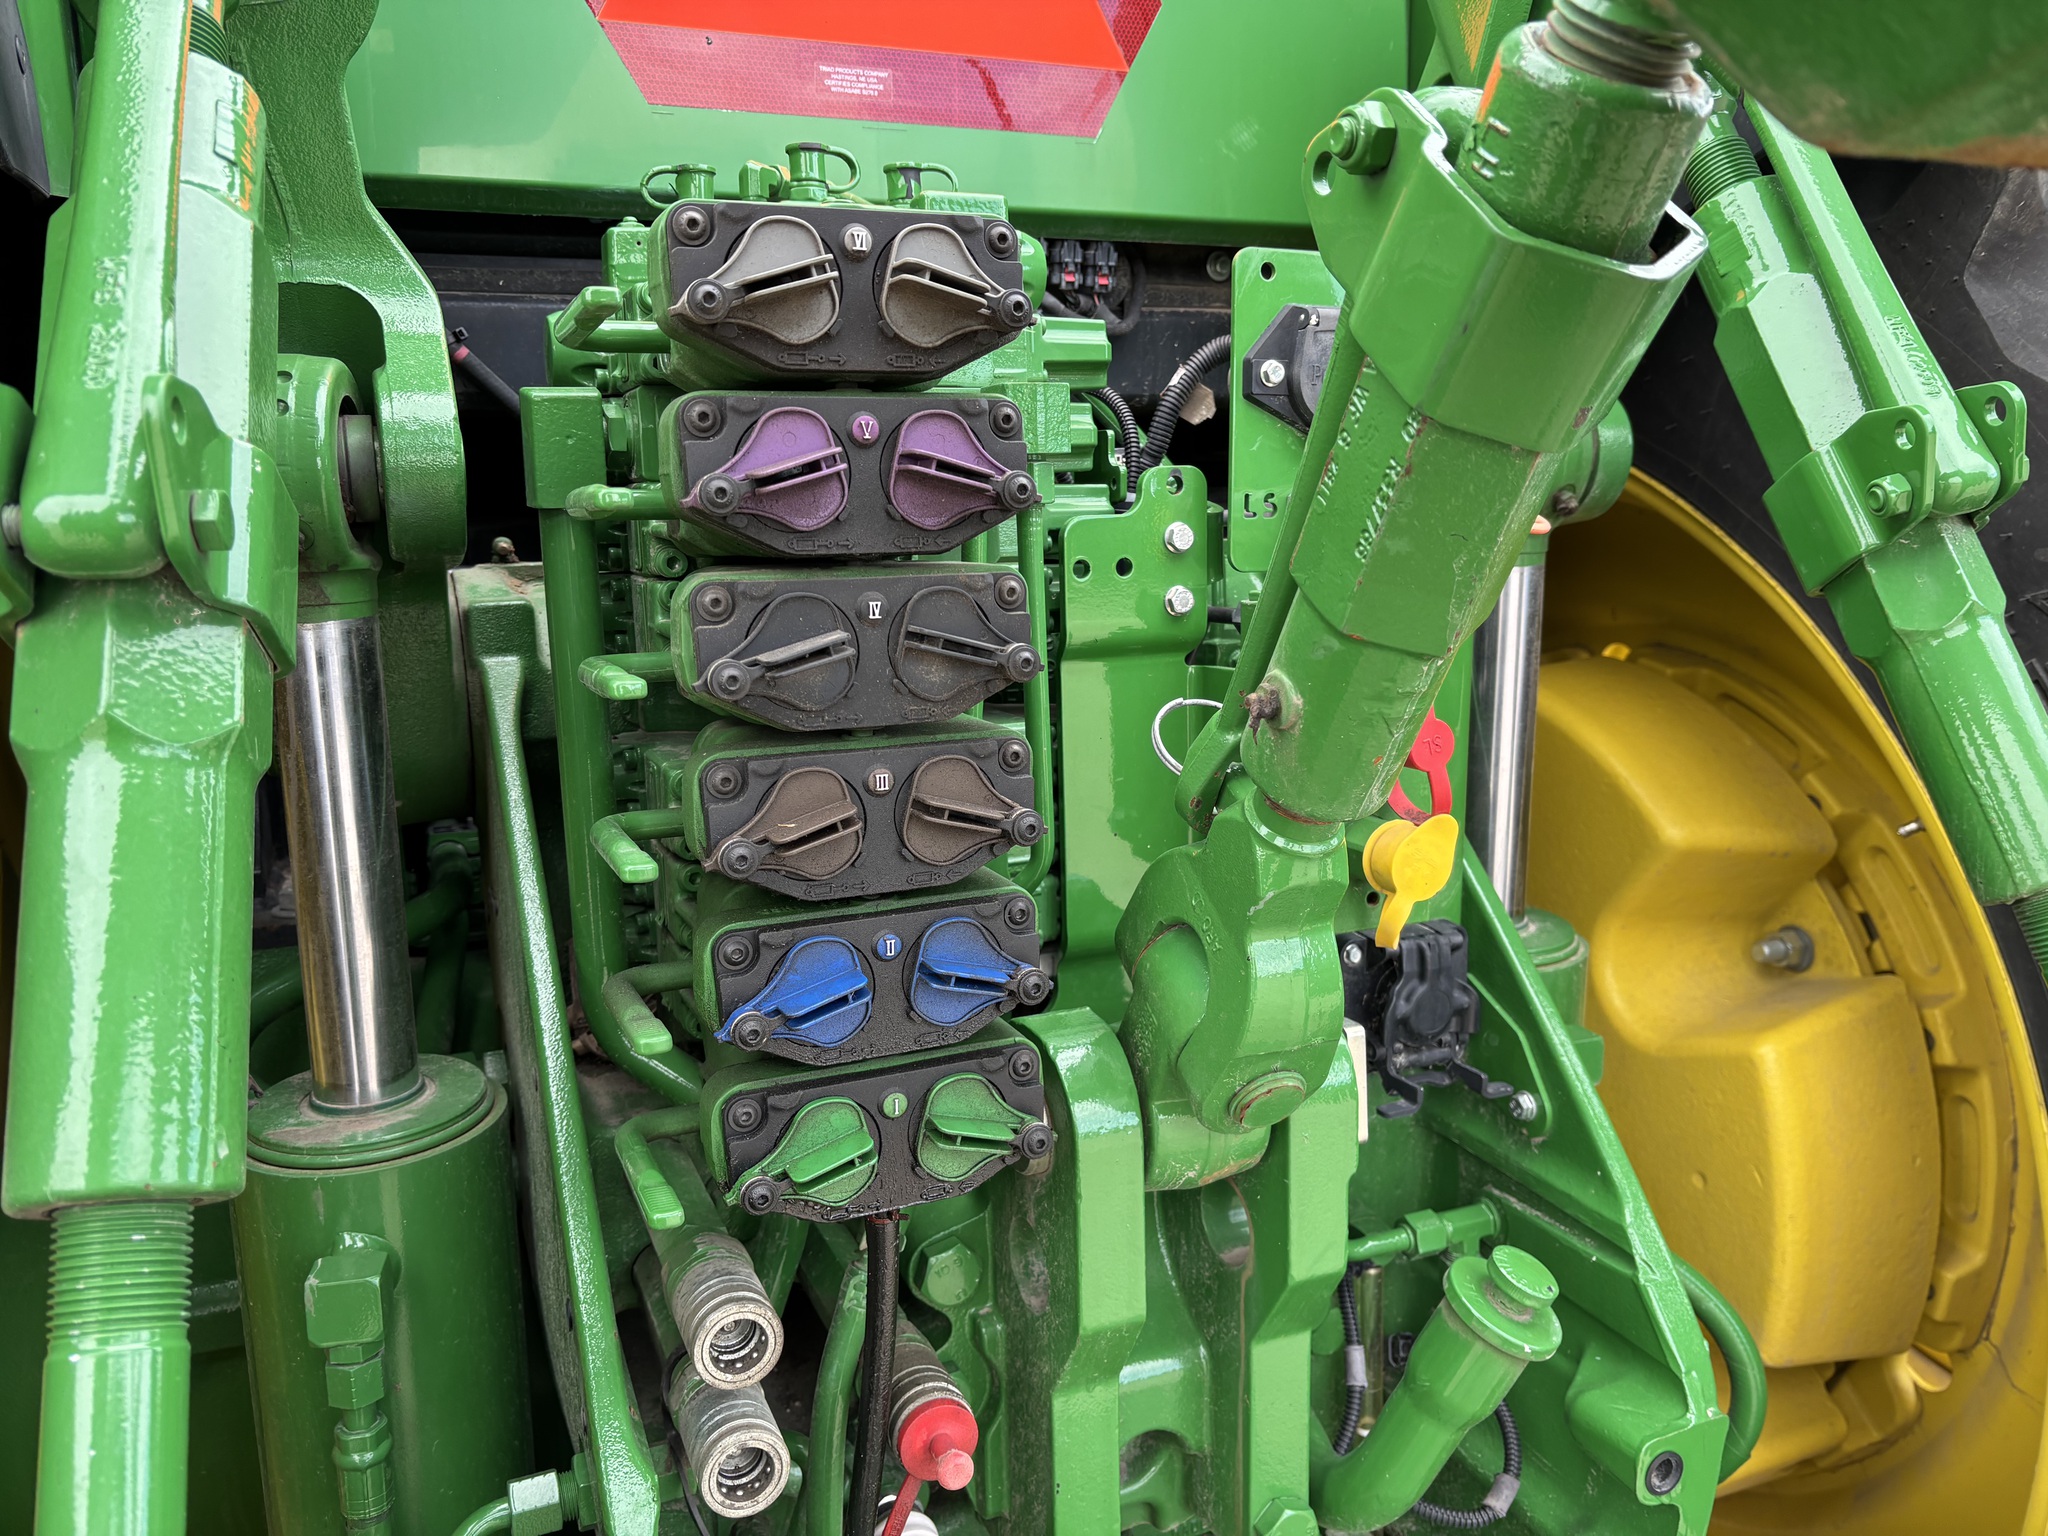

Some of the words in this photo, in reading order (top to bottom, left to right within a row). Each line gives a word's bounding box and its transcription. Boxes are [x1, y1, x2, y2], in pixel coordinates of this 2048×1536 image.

[852, 231, 868, 251] VI
[860, 420, 874, 439] V
[1244, 492, 1278, 519] LS
[868, 601, 882, 619] IV
[875, 773, 890, 791] III
[885, 939, 896, 956] II
[894, 1098, 900, 1115] I
